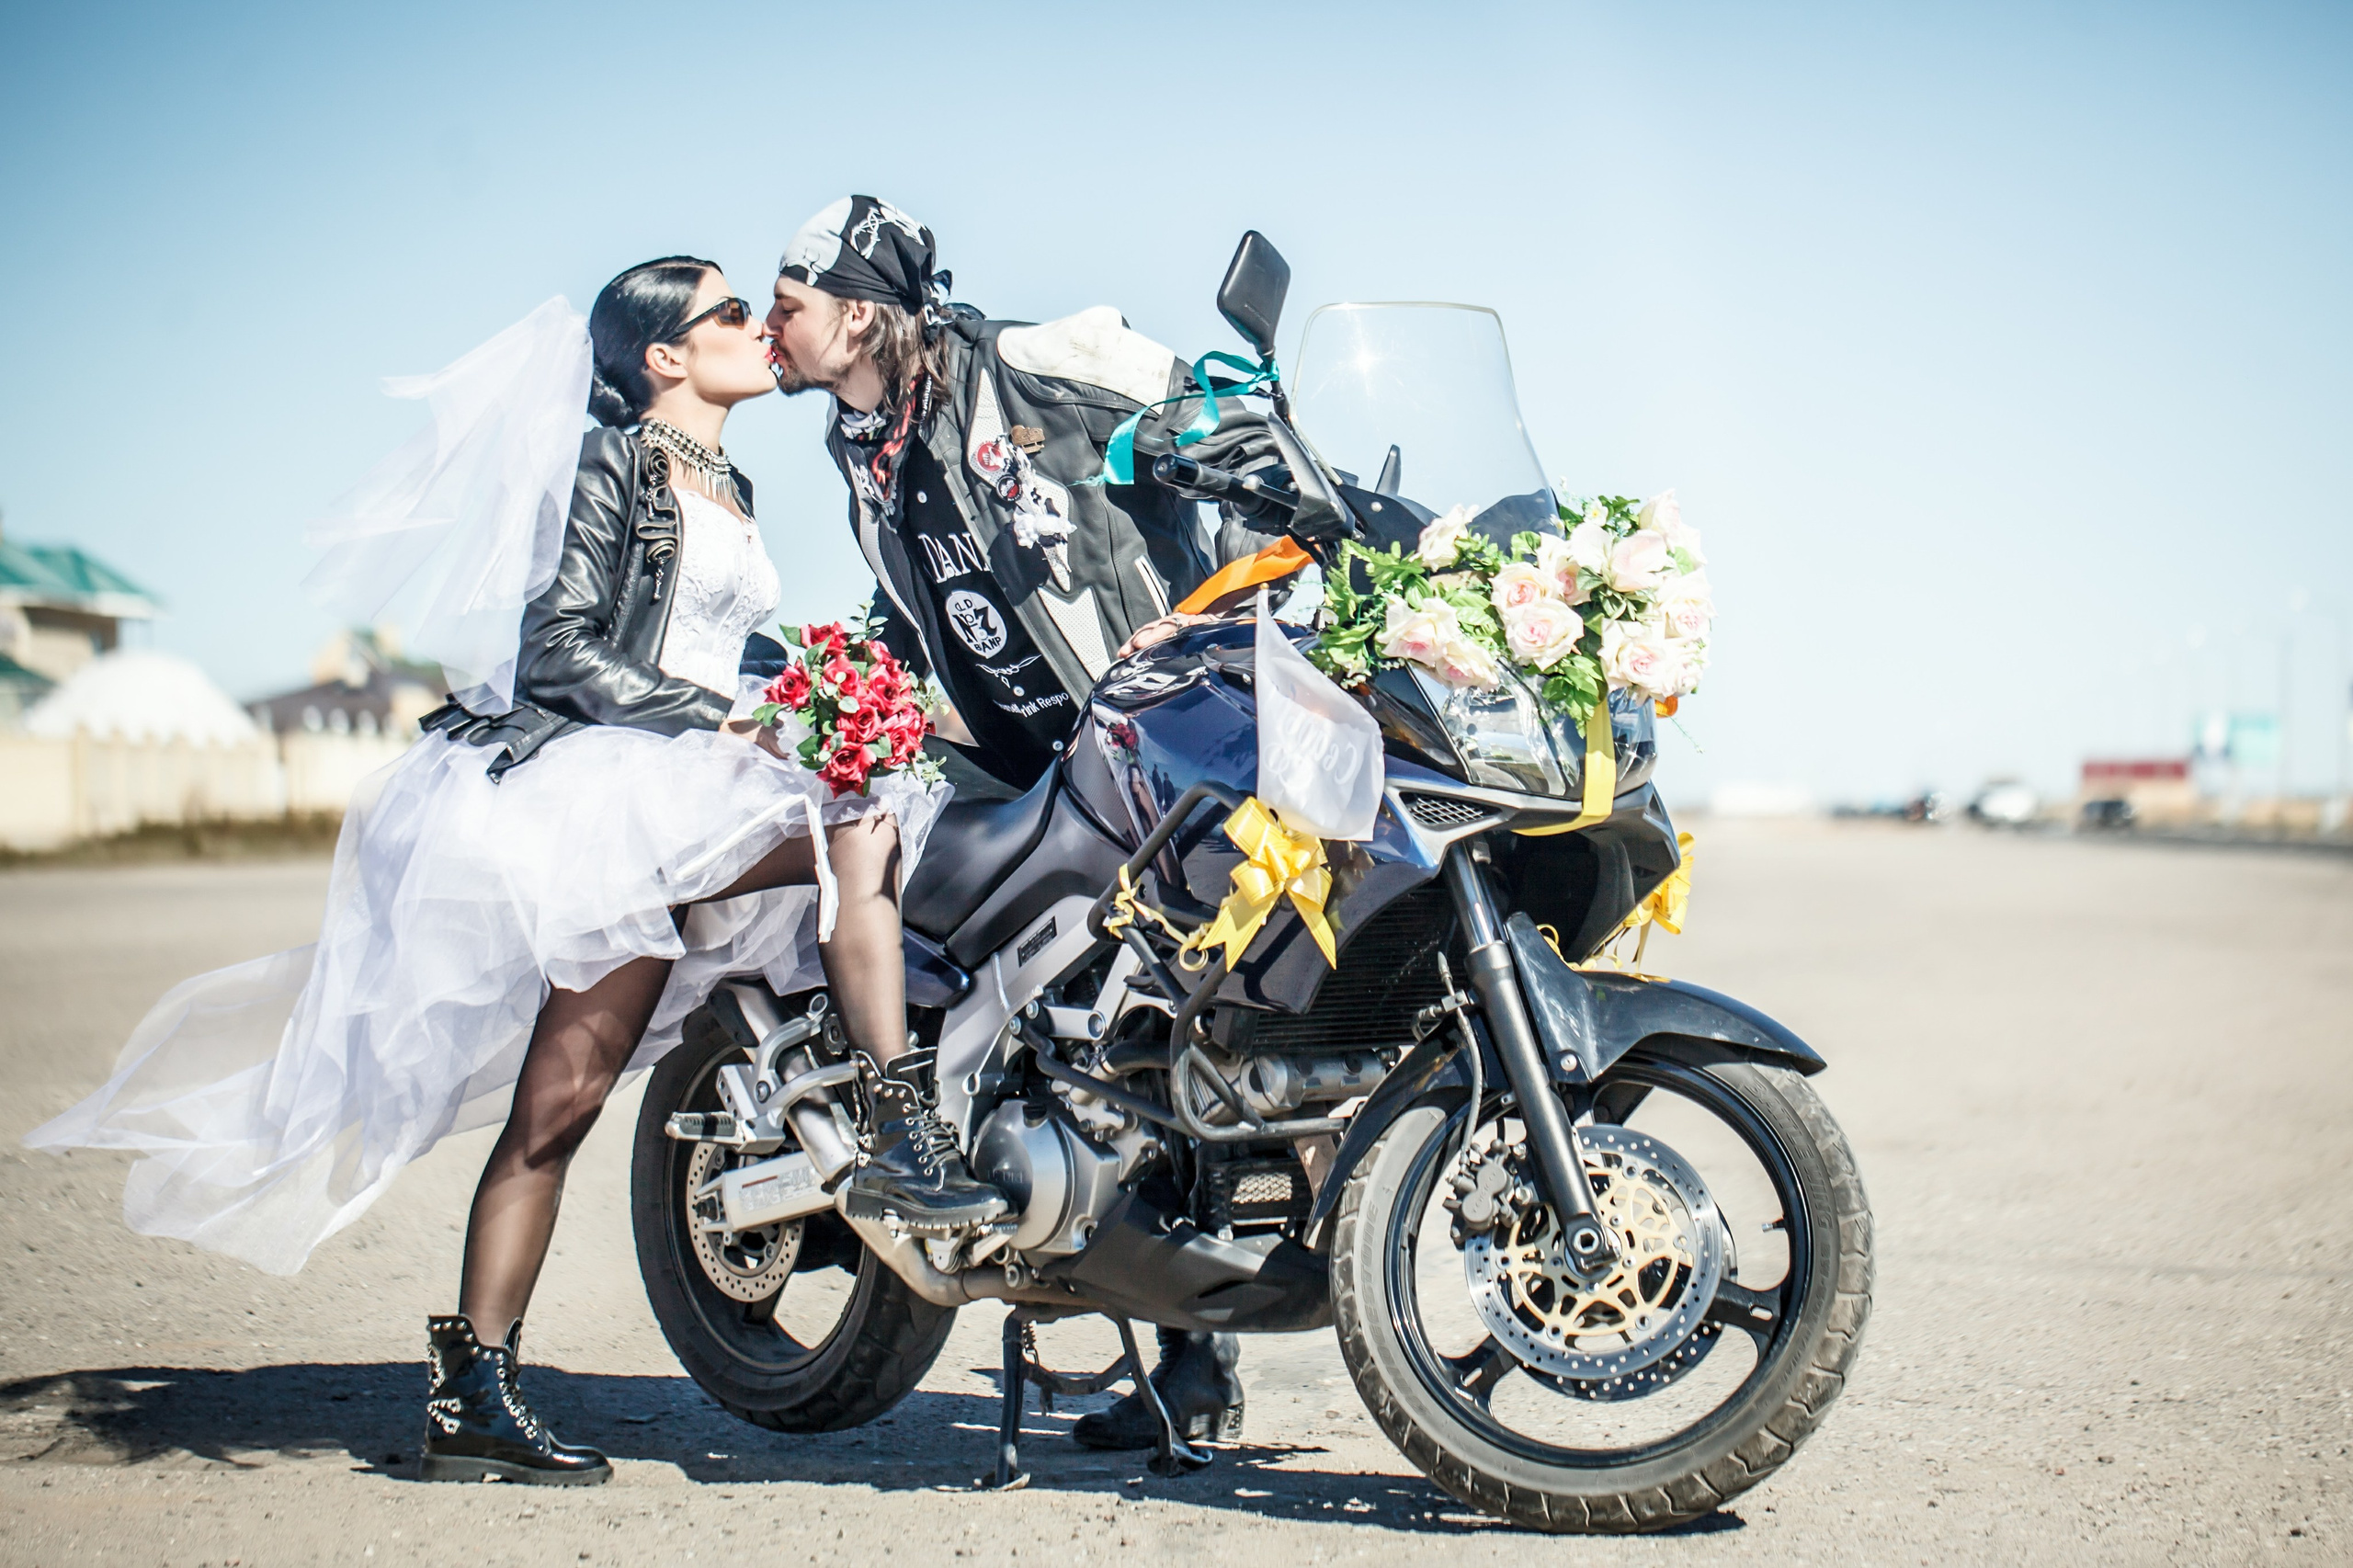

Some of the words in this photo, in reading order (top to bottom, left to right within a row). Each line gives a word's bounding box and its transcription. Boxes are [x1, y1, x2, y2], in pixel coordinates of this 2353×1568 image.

[917, 532, 991, 584] DAN
[1020, 700, 1040, 718] rink
[1803, 1162, 1834, 1230] WING
